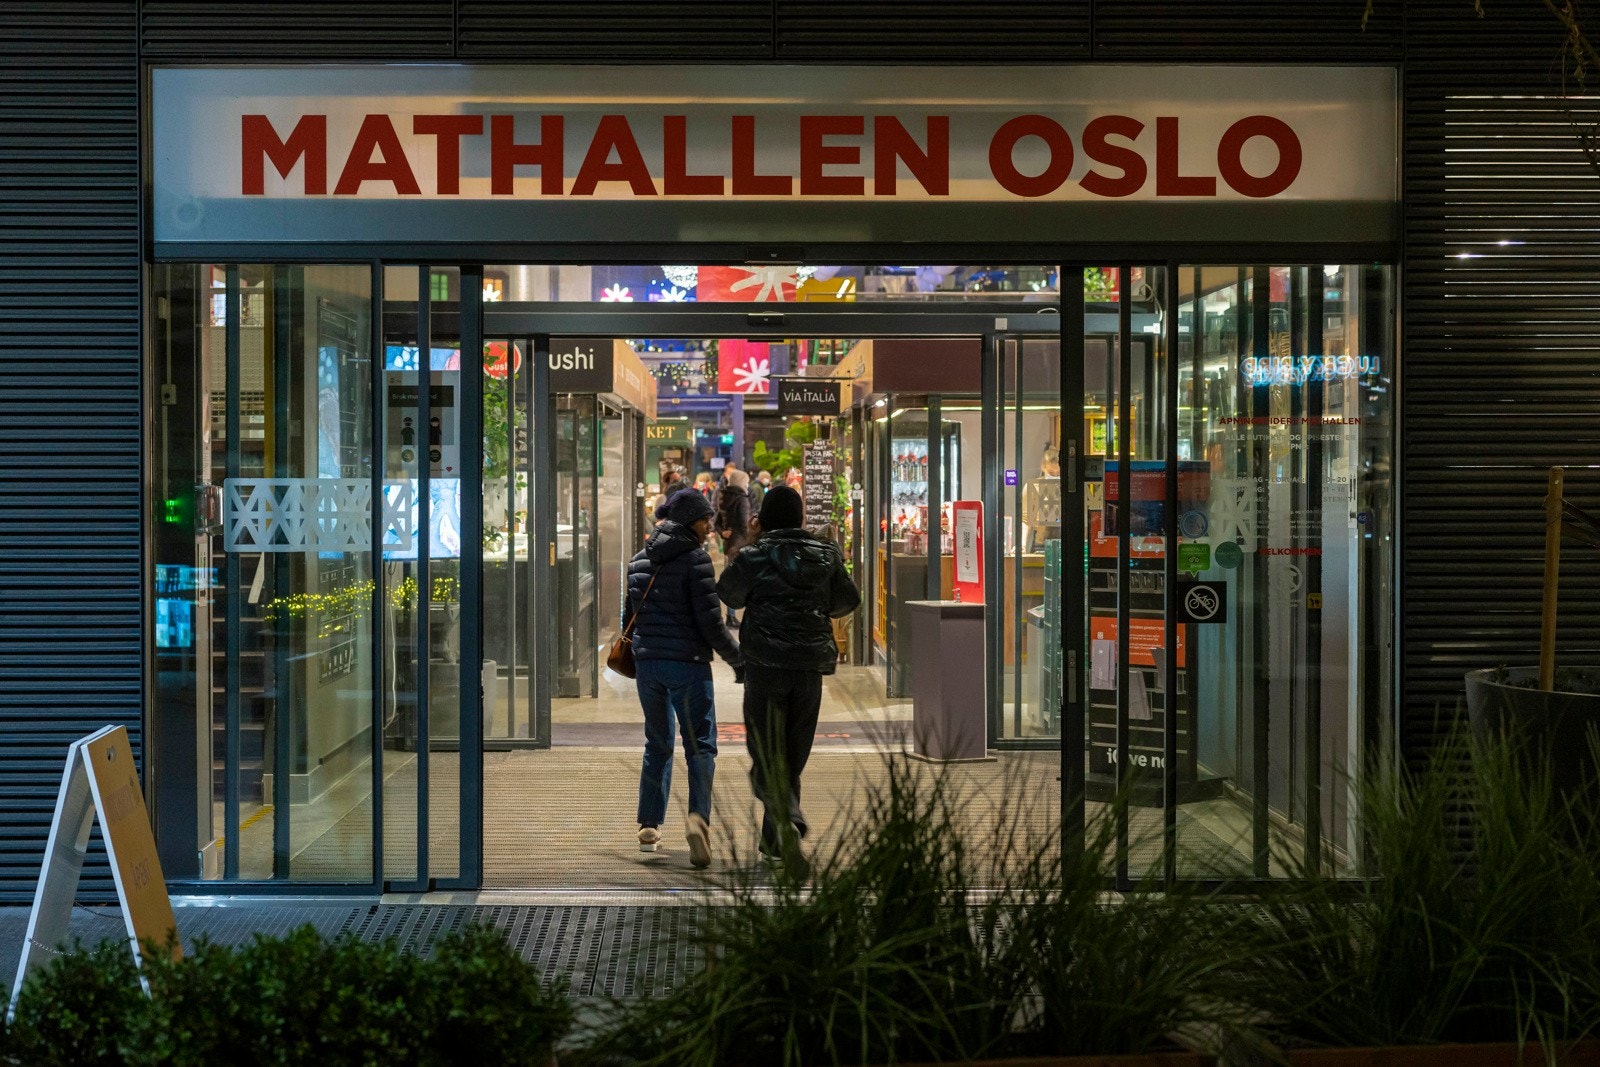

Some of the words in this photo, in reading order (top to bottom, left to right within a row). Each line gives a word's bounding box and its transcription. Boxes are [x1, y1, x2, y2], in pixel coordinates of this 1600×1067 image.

[242, 114, 949, 195] MATHALLEN
[988, 114, 1302, 197] OSLO
[549, 346, 594, 370] ushi
[646, 426, 676, 439] KET
